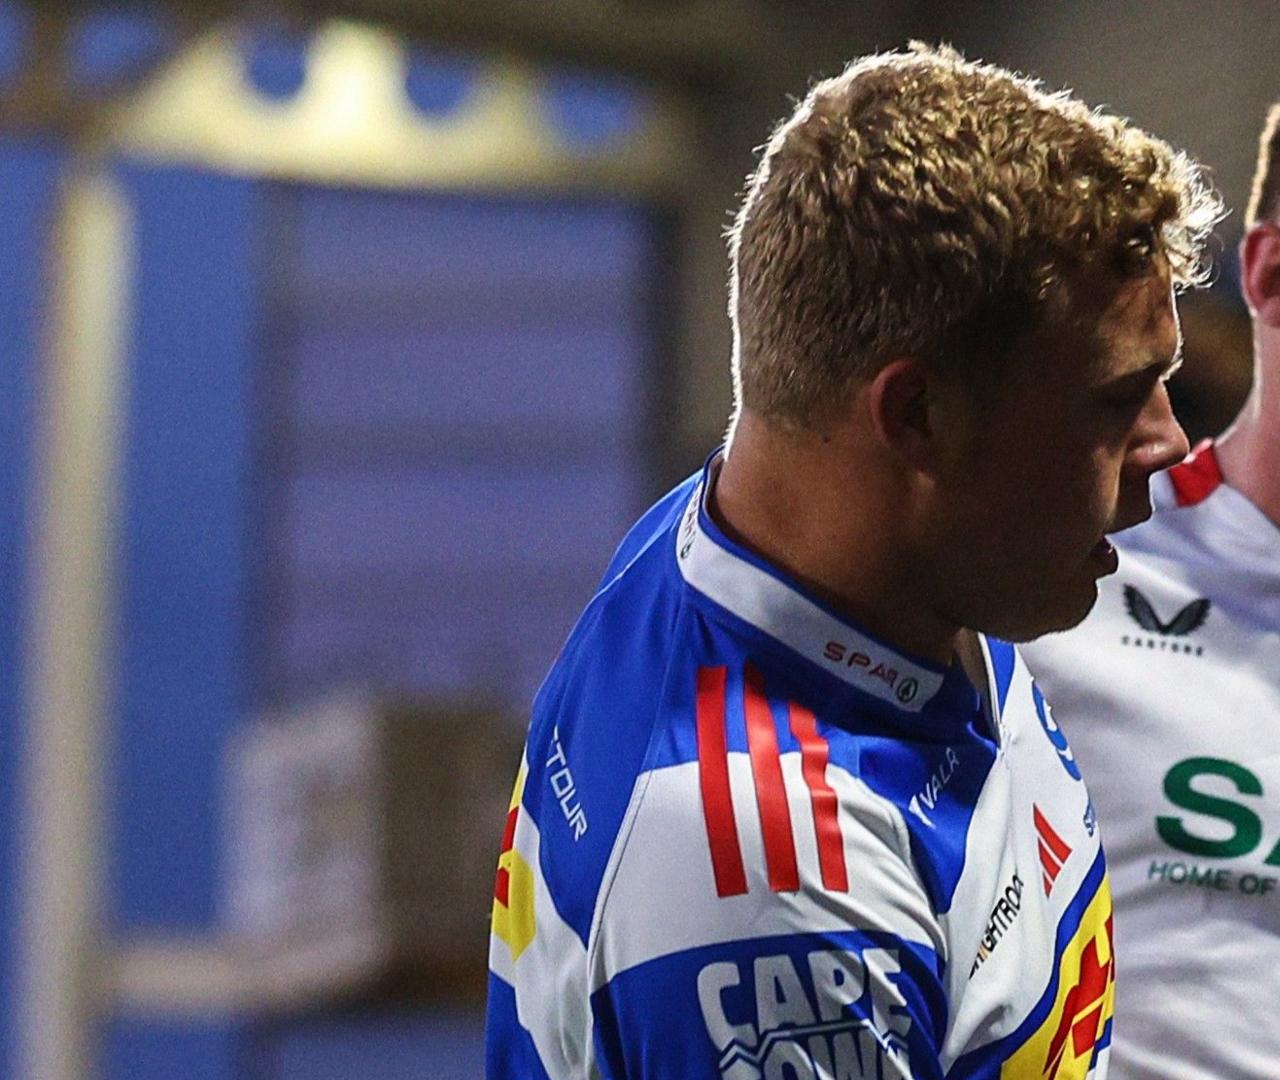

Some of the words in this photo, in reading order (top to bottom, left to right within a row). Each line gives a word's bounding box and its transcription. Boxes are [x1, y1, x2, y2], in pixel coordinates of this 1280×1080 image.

[823, 641, 899, 689] SPAR
[1148, 860, 1231, 892] HOME
[1238, 872, 1279, 897] OF
[697, 947, 913, 1053] CAPE
